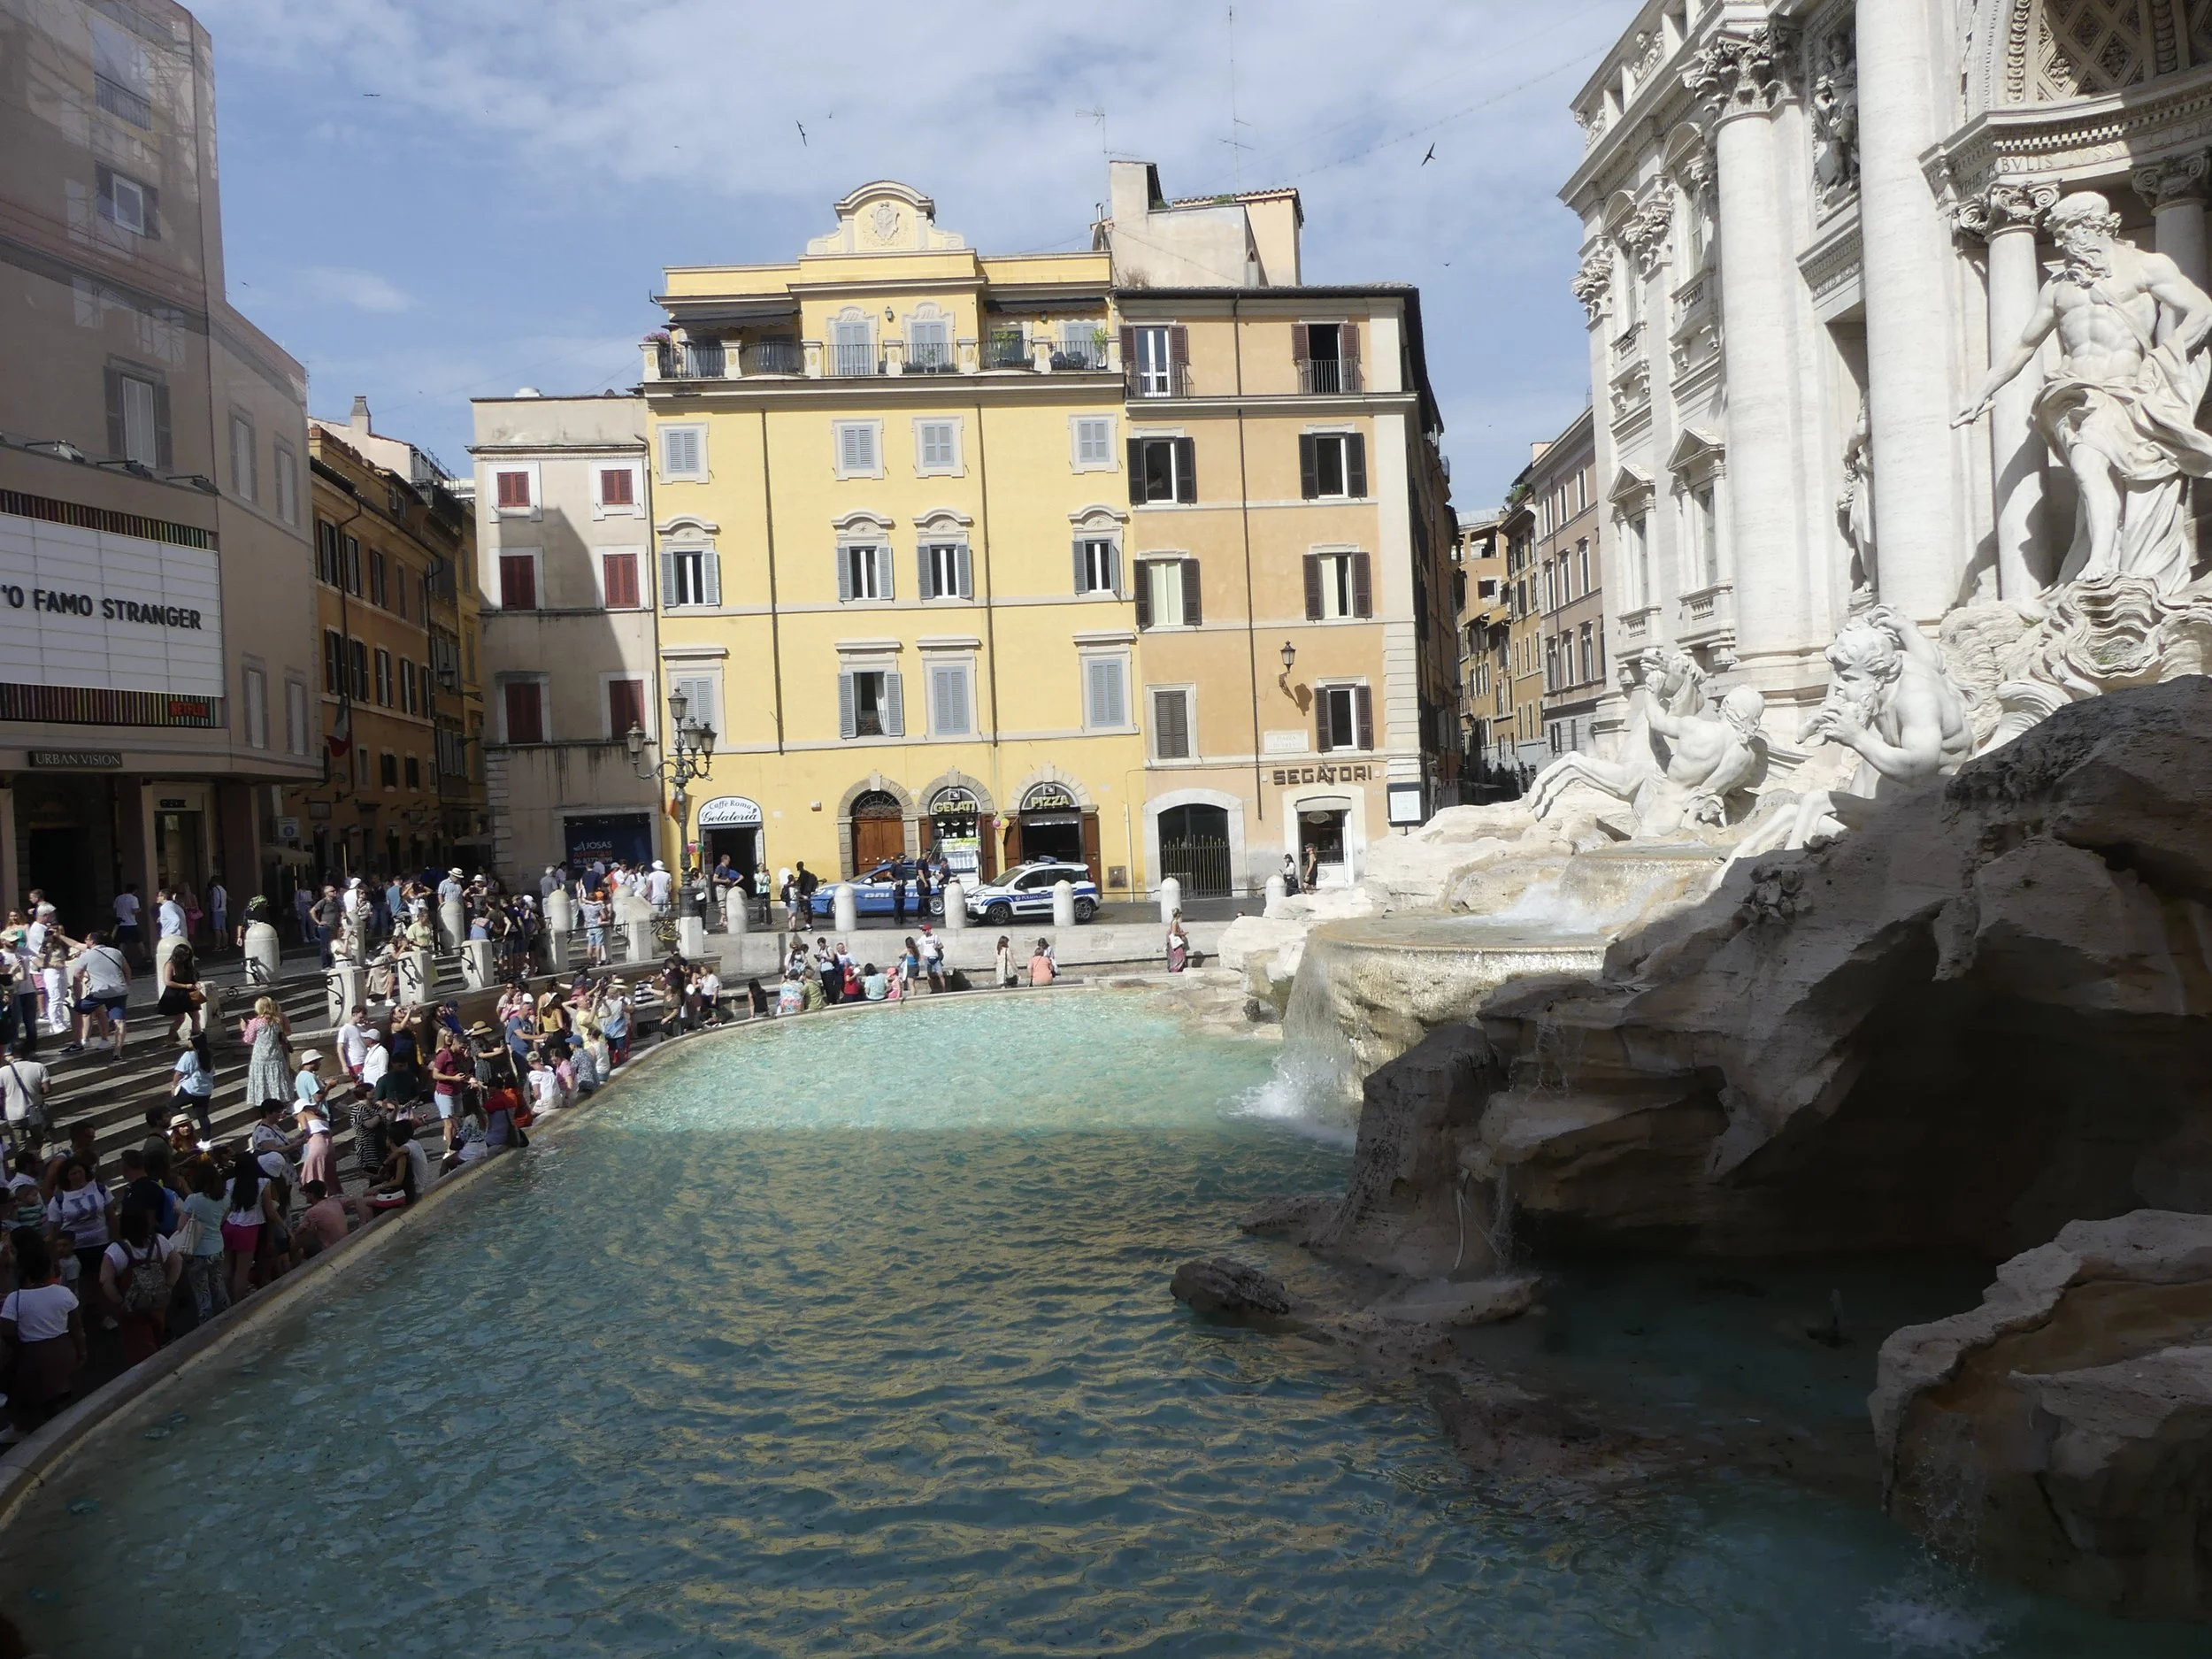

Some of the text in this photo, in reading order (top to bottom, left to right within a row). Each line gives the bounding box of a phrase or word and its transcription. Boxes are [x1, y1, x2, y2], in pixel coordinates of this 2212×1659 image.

[34, 588, 94, 617] FAMO
[102, 598, 202, 630] STRANGER
[35, 753, 121, 766] URBAN VISION
[1272, 765, 1372, 786] SEGATORI
[730, 800, 752, 810] Roma
[933, 801, 977, 813] GELATI
[1031, 795, 1070, 808] PIZZA
[701, 810, 757, 823] Gelateria
